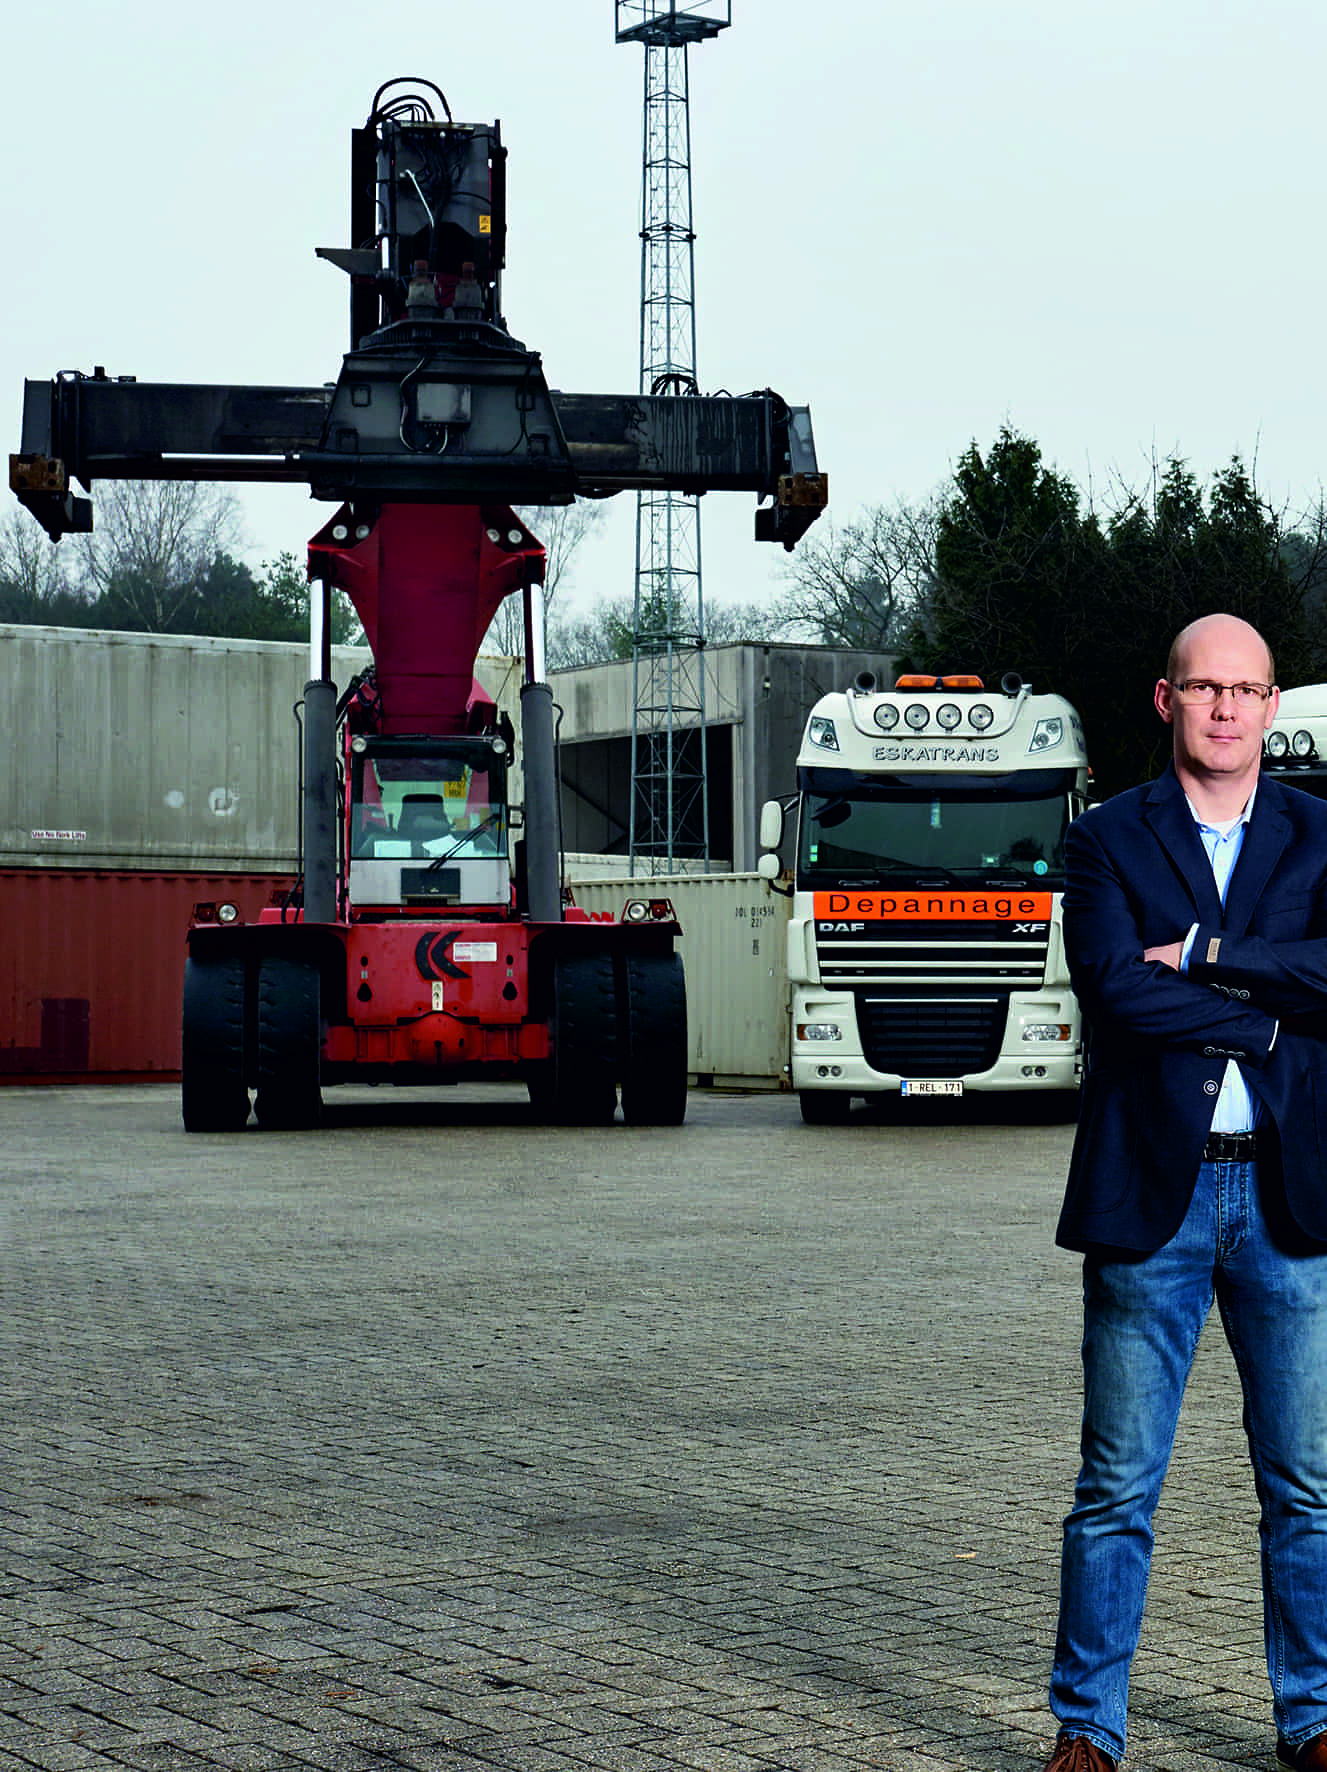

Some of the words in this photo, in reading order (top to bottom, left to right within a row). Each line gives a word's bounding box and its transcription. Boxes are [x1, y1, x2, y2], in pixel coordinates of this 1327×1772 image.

[873, 746, 1000, 762] ESKATRANS
[829, 894, 1036, 917] Depannage
[818, 922, 865, 933] DAF
[1011, 923, 1048, 933] XF
